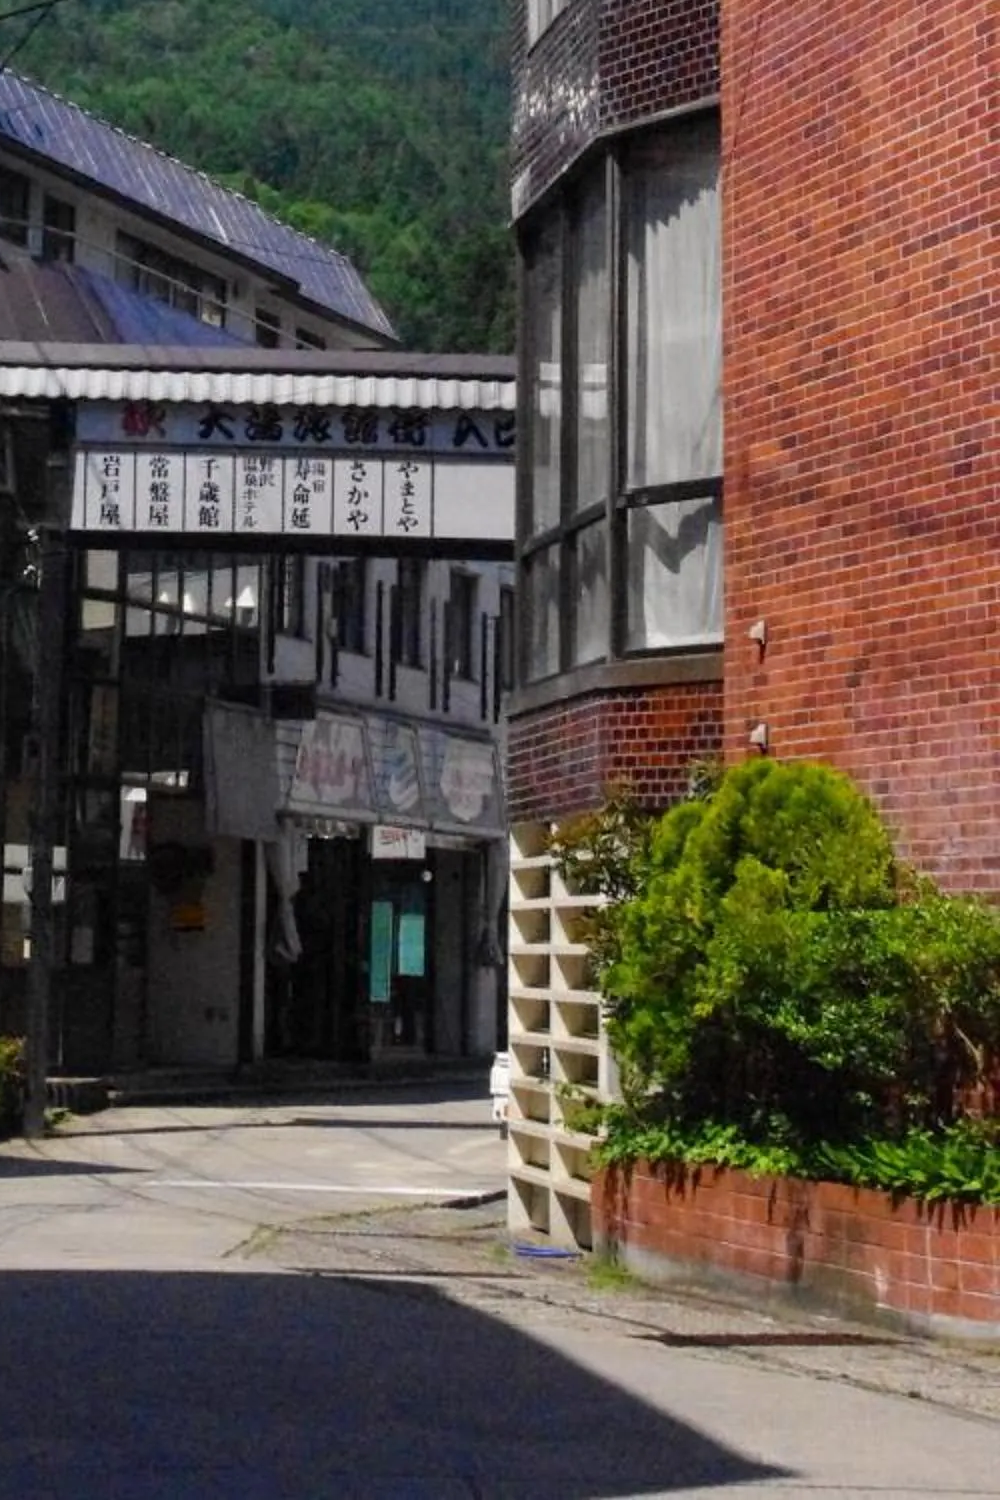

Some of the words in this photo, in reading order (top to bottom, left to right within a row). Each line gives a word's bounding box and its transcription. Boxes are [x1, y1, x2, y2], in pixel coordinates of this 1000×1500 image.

[99, 455, 122, 528] 岩戸屋
[148, 455, 170, 528] 常盤屋
[199, 457, 221, 528] 千歳館
[347, 460, 369, 531] さかや
[397, 461, 420, 533] やまとや
